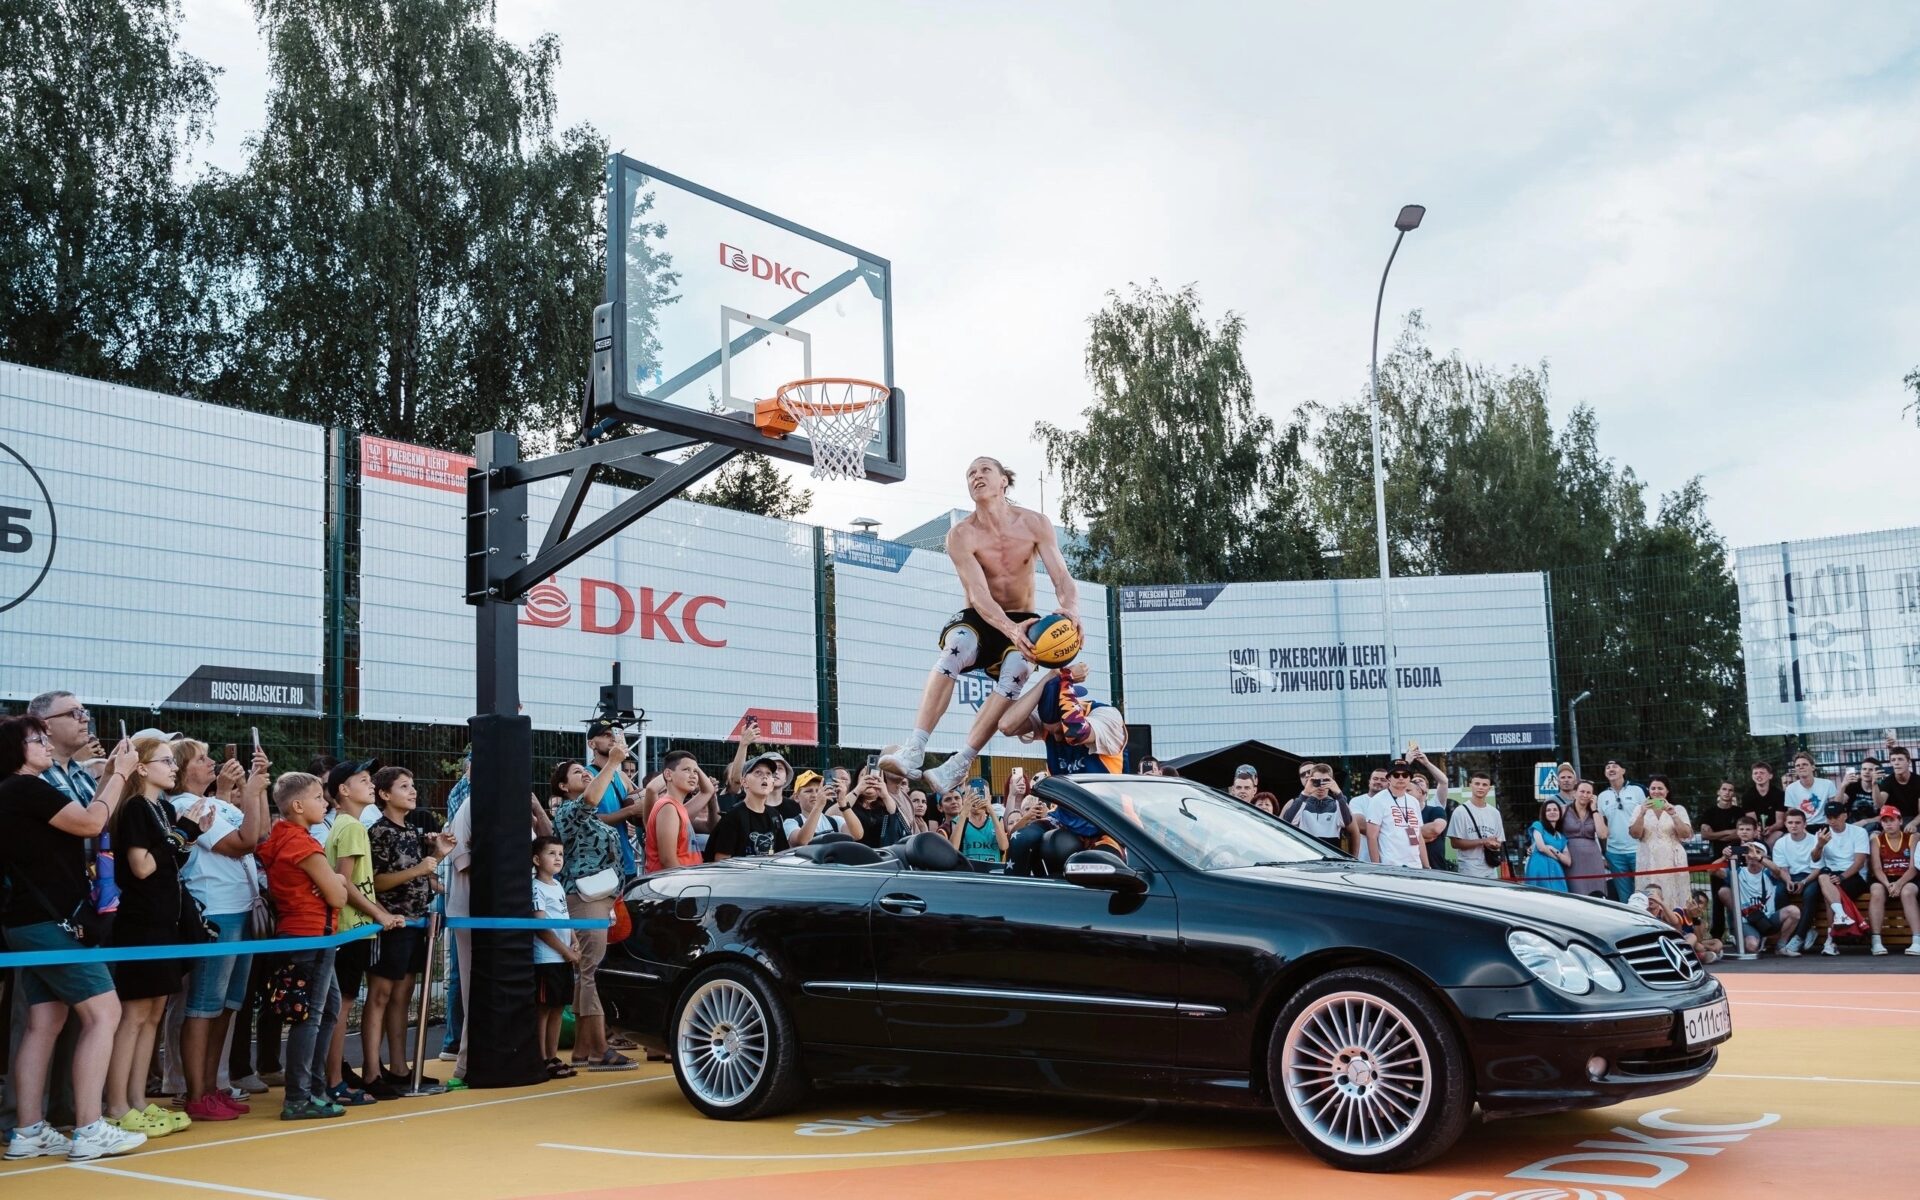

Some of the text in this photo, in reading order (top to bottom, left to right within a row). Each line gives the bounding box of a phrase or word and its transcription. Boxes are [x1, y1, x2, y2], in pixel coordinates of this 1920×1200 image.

[752, 254, 810, 295] DKC
[387, 447, 426, 467] РЖЕВСКИЙ
[428, 456, 449, 471] ЦЕНТР
[425, 469, 467, 488] БАСКЕТБОЛ
[580, 577, 728, 648] DKC
[1054, 640, 1080, 659] ORRES
[1270, 643, 1397, 669] РЖЕВСКИЙ ЦЕНТ
[957, 675, 994, 702] ТВЕ
[1350, 667, 1442, 690] БАСКТБОЛА
[211, 681, 304, 705] RUSSIABASKET.RU
[771, 721, 792, 735] DKC.RU
[1490, 731, 1532, 744] TVERSBC.RU
[1504, 1108, 1781, 1188] DKC
